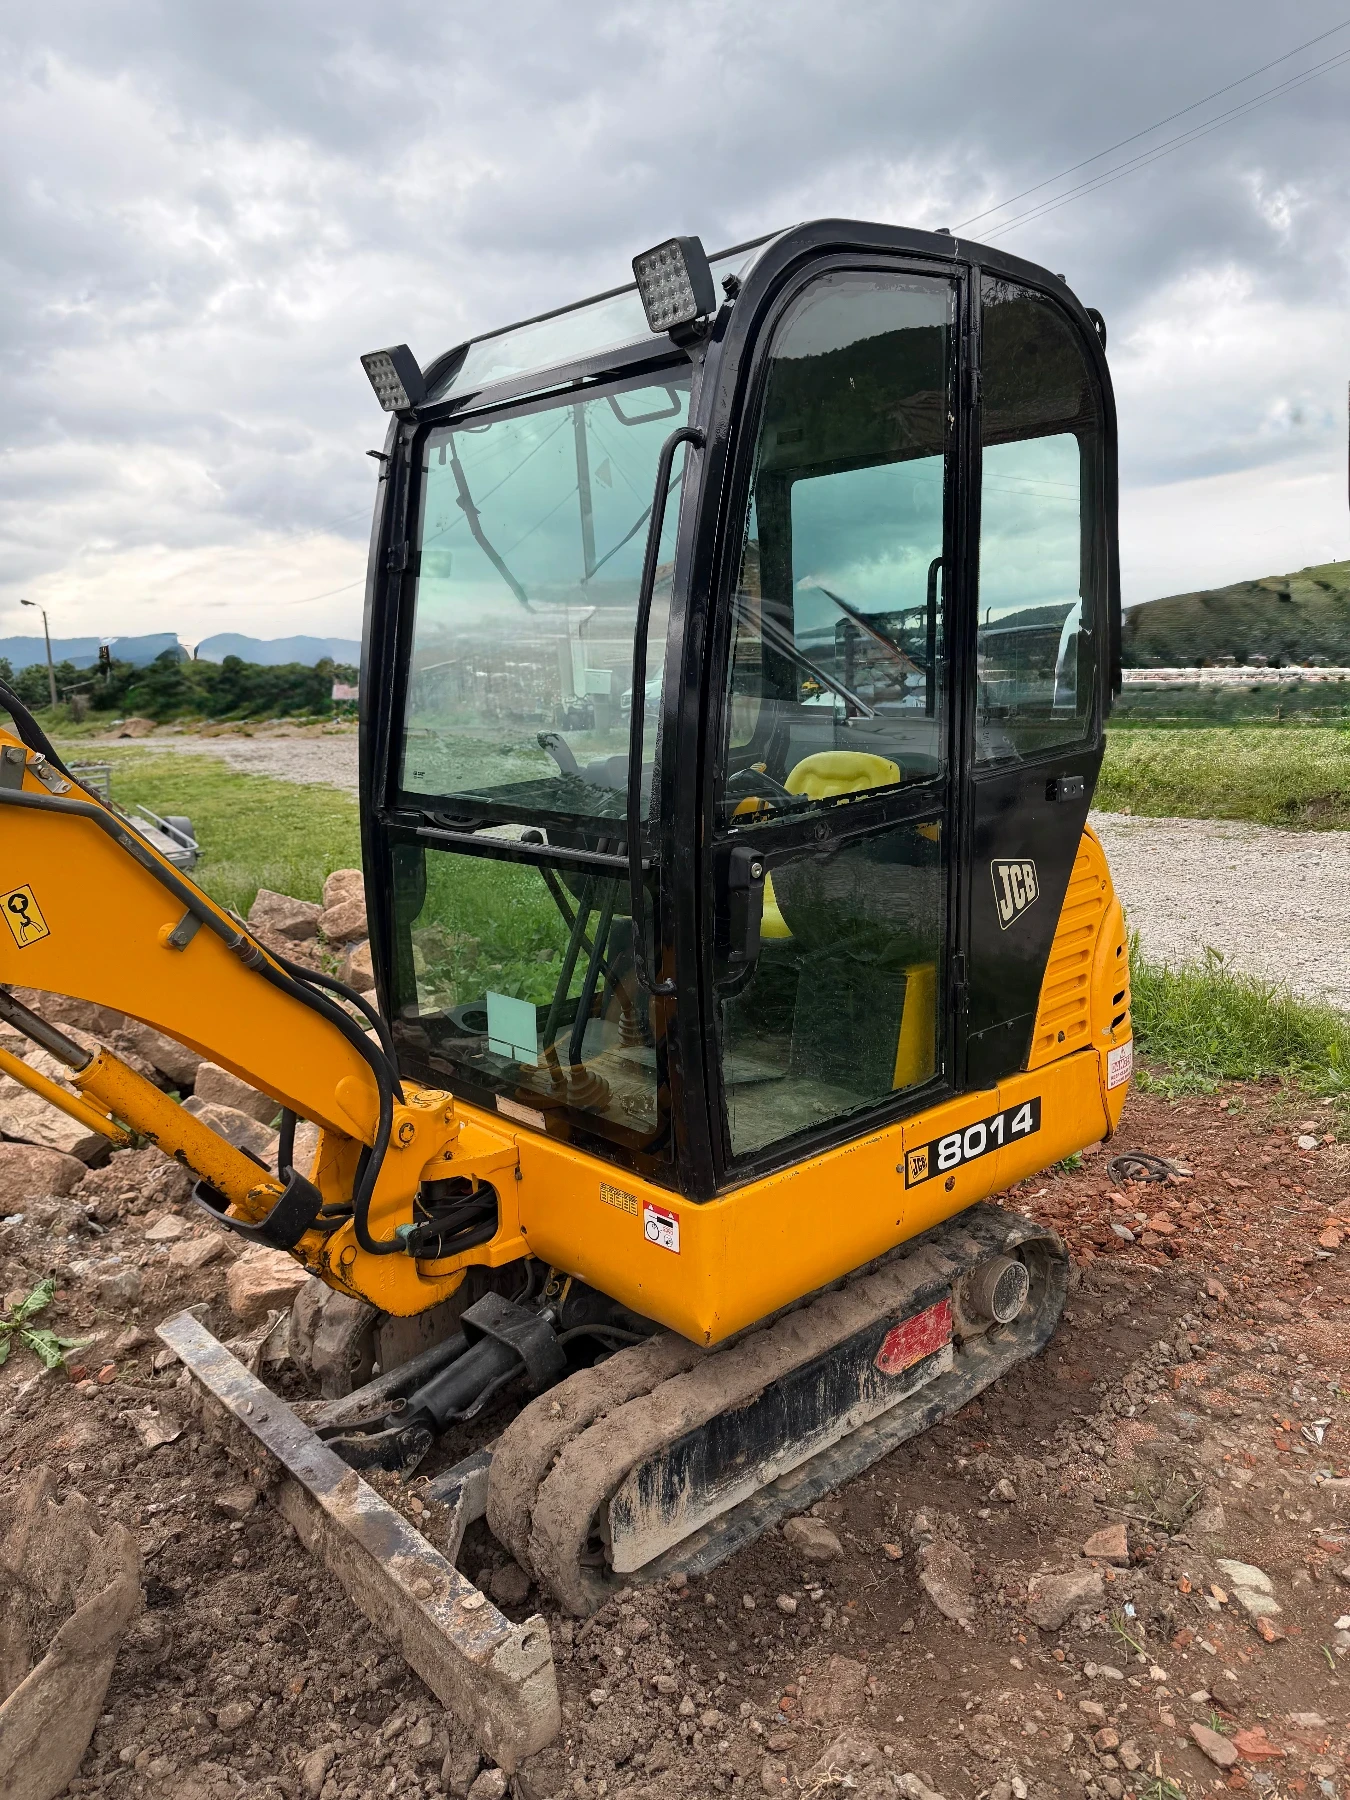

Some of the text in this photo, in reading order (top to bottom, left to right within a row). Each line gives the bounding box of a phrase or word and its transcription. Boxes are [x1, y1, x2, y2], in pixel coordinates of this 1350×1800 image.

[998, 863, 1036, 921] JCB
[938, 1103, 1034, 1170] 8014
[912, 1157, 927, 1175] JCB
